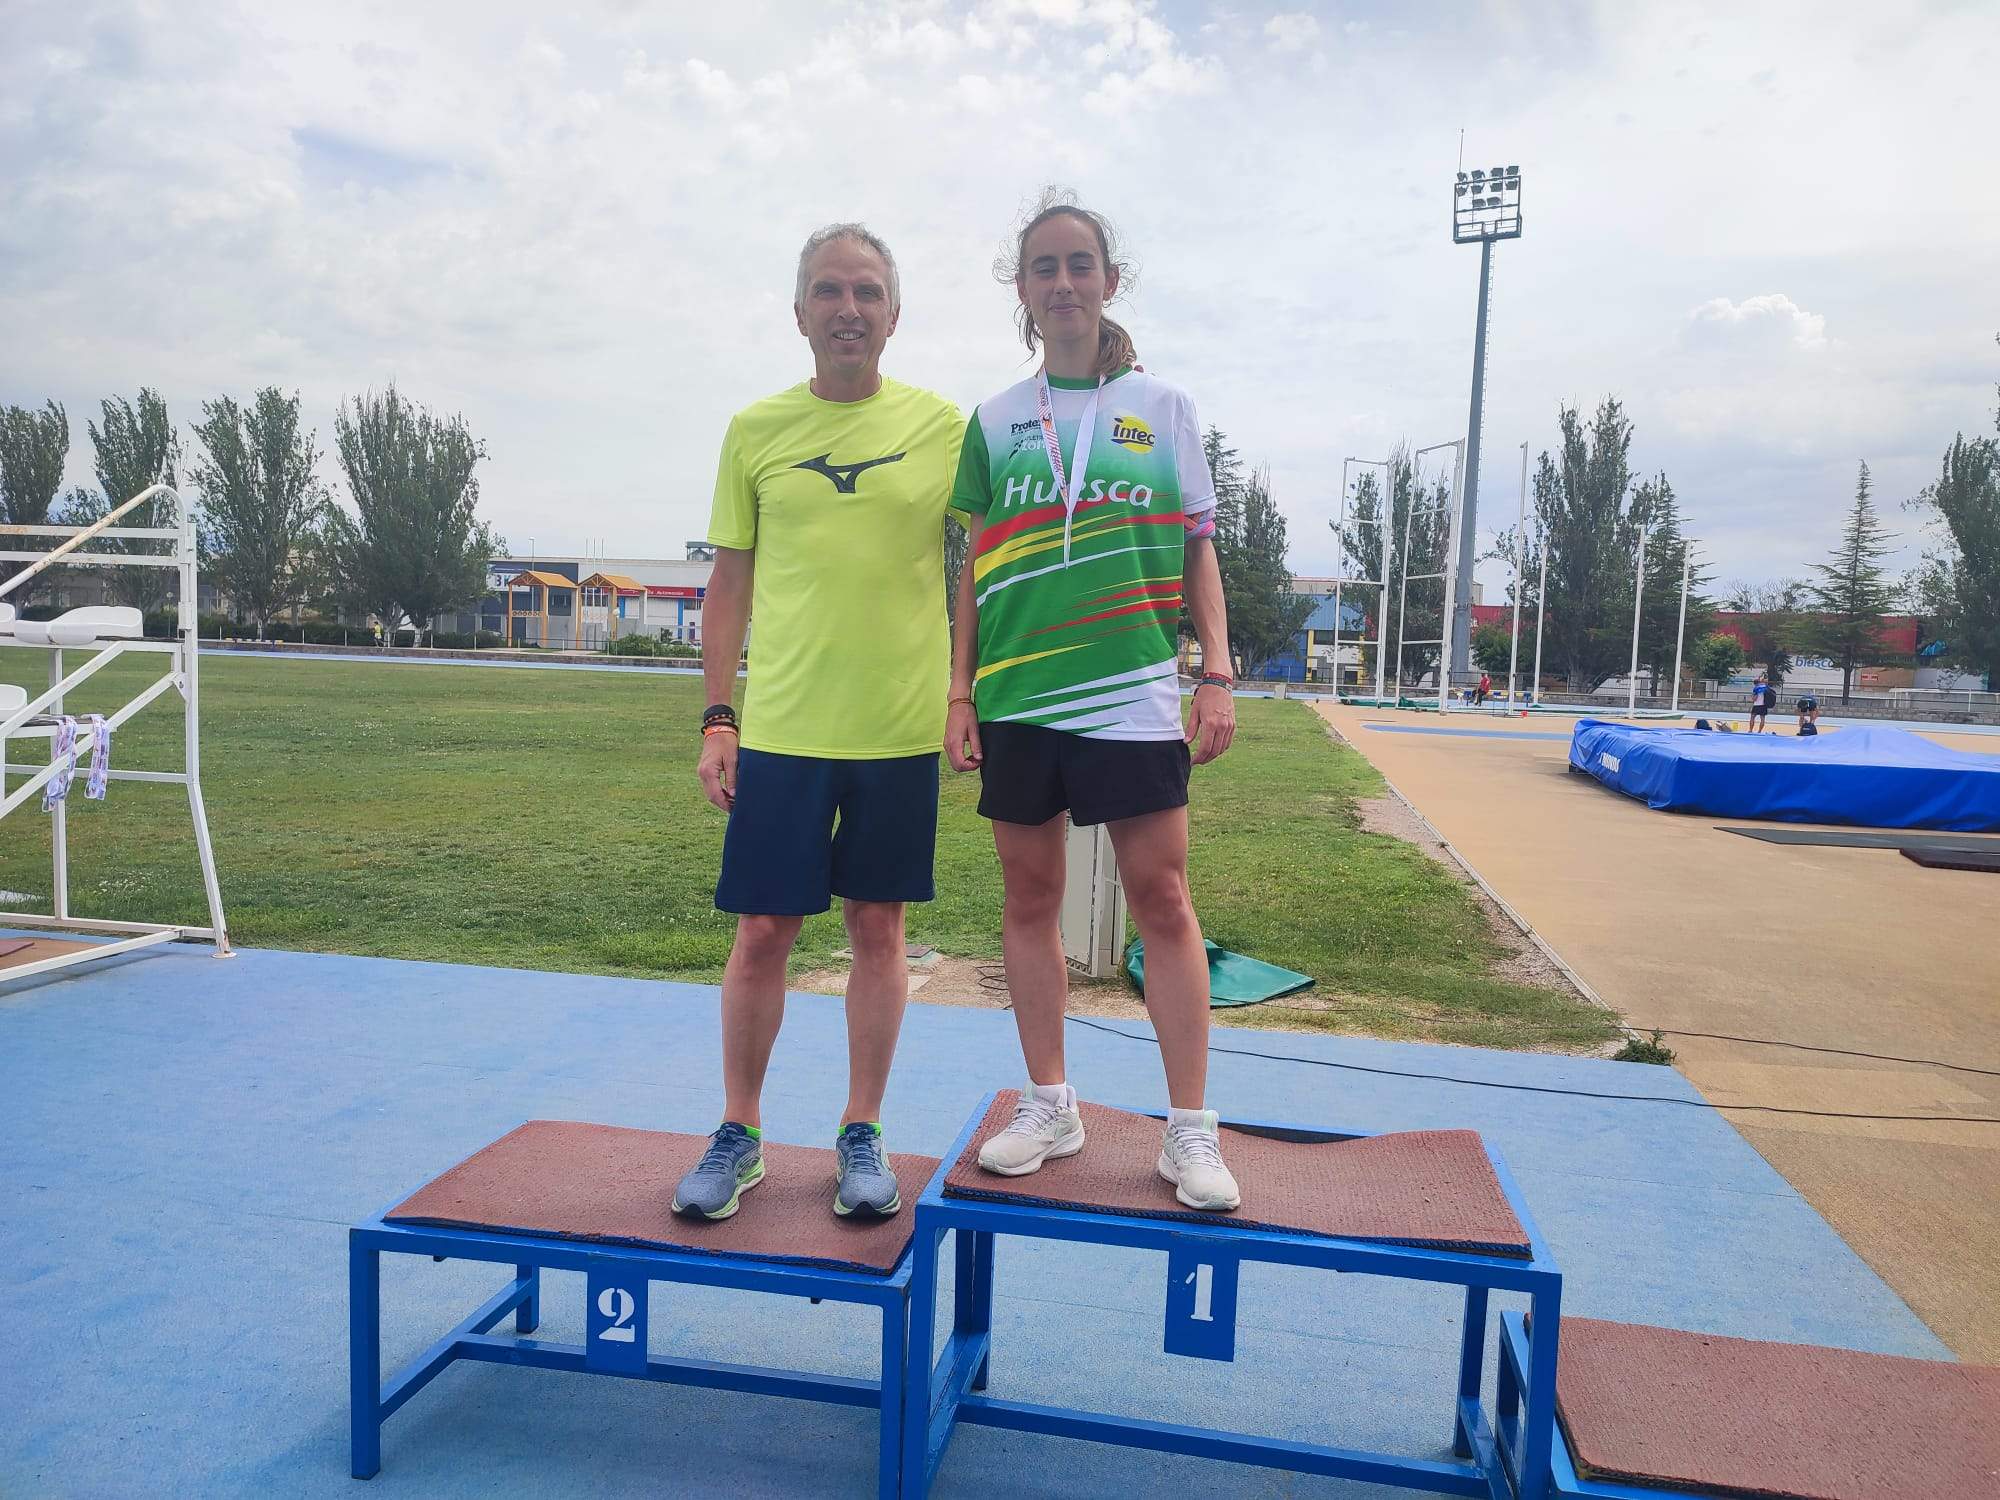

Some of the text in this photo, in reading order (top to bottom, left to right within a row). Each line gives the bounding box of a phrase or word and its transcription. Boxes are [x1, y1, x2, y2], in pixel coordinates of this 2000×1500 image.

[1004, 474, 1153, 509] Husca
[597, 1287, 636, 1343] 2
[1185, 1263, 1214, 1321] 1
